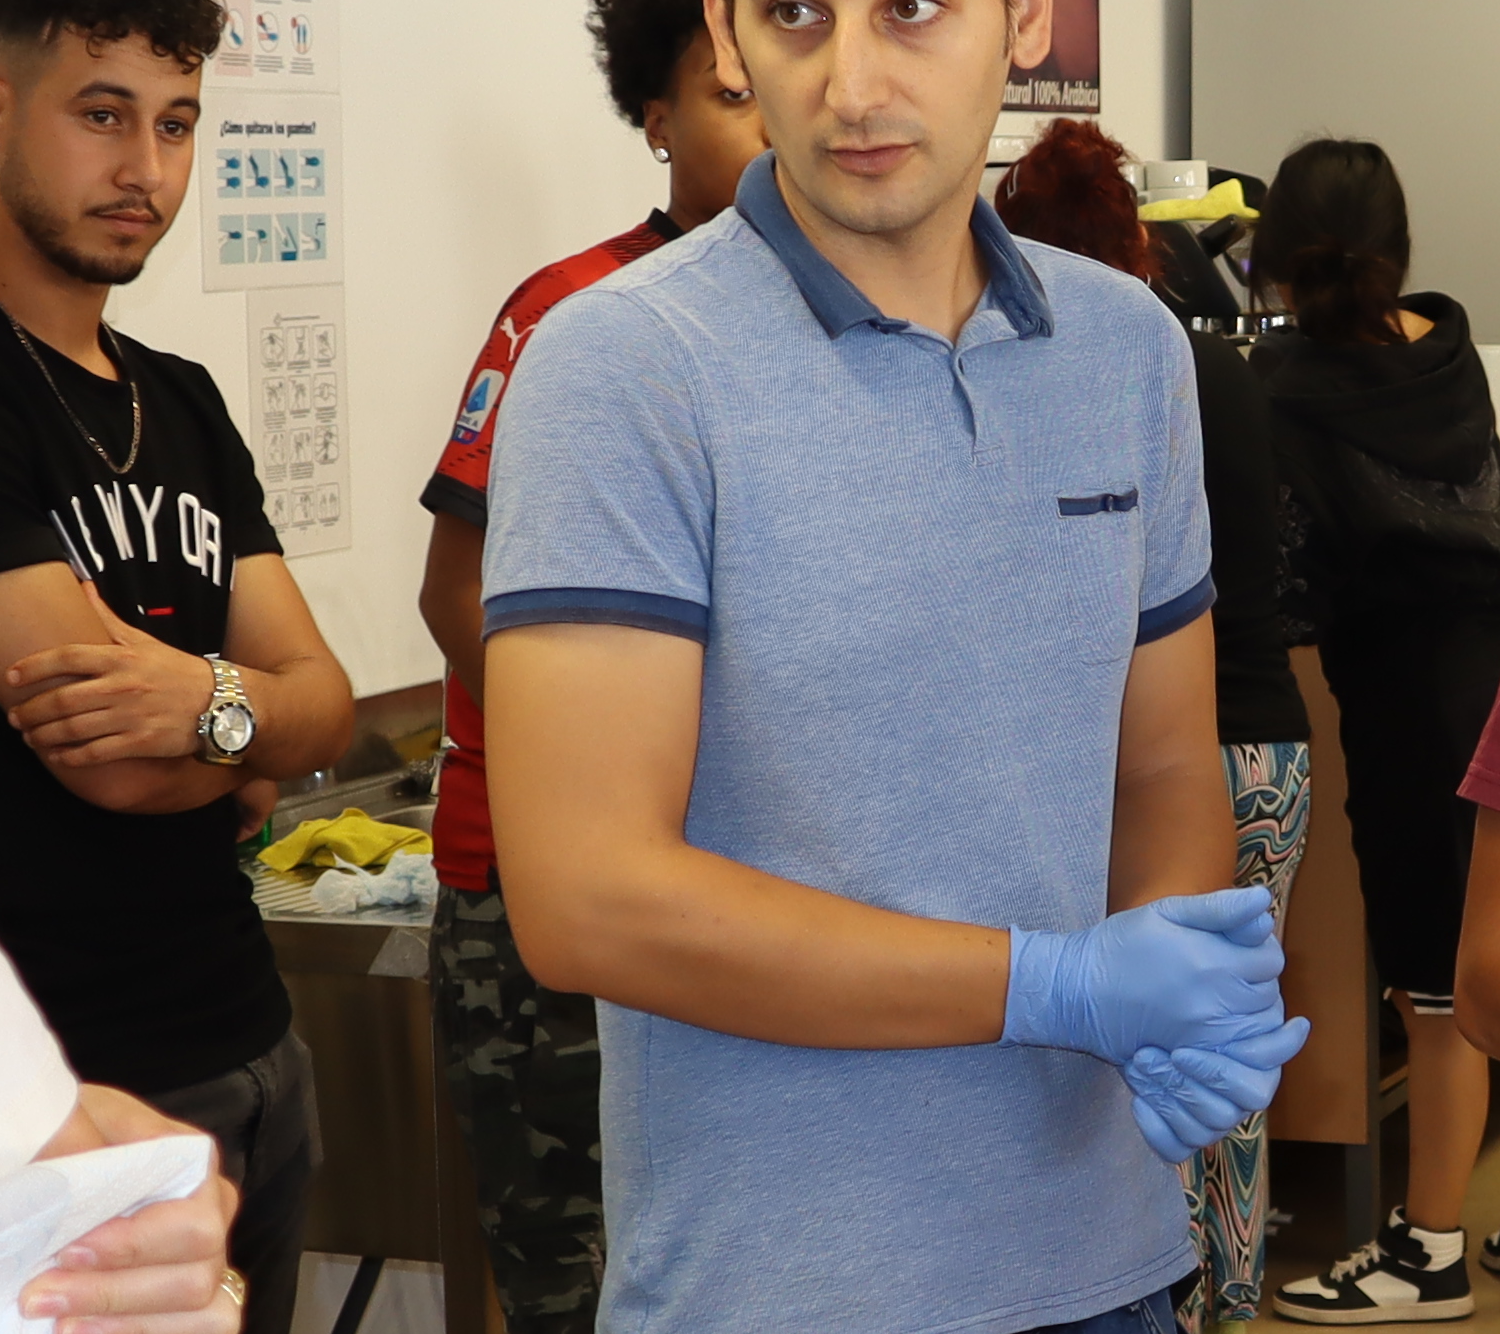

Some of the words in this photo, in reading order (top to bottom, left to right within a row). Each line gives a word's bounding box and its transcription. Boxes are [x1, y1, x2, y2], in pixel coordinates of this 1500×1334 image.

[1034, 80, 1060, 106] 100%
[1061, 79, 1099, 107] Arábica
[128, 483, 235, 592] YOR
